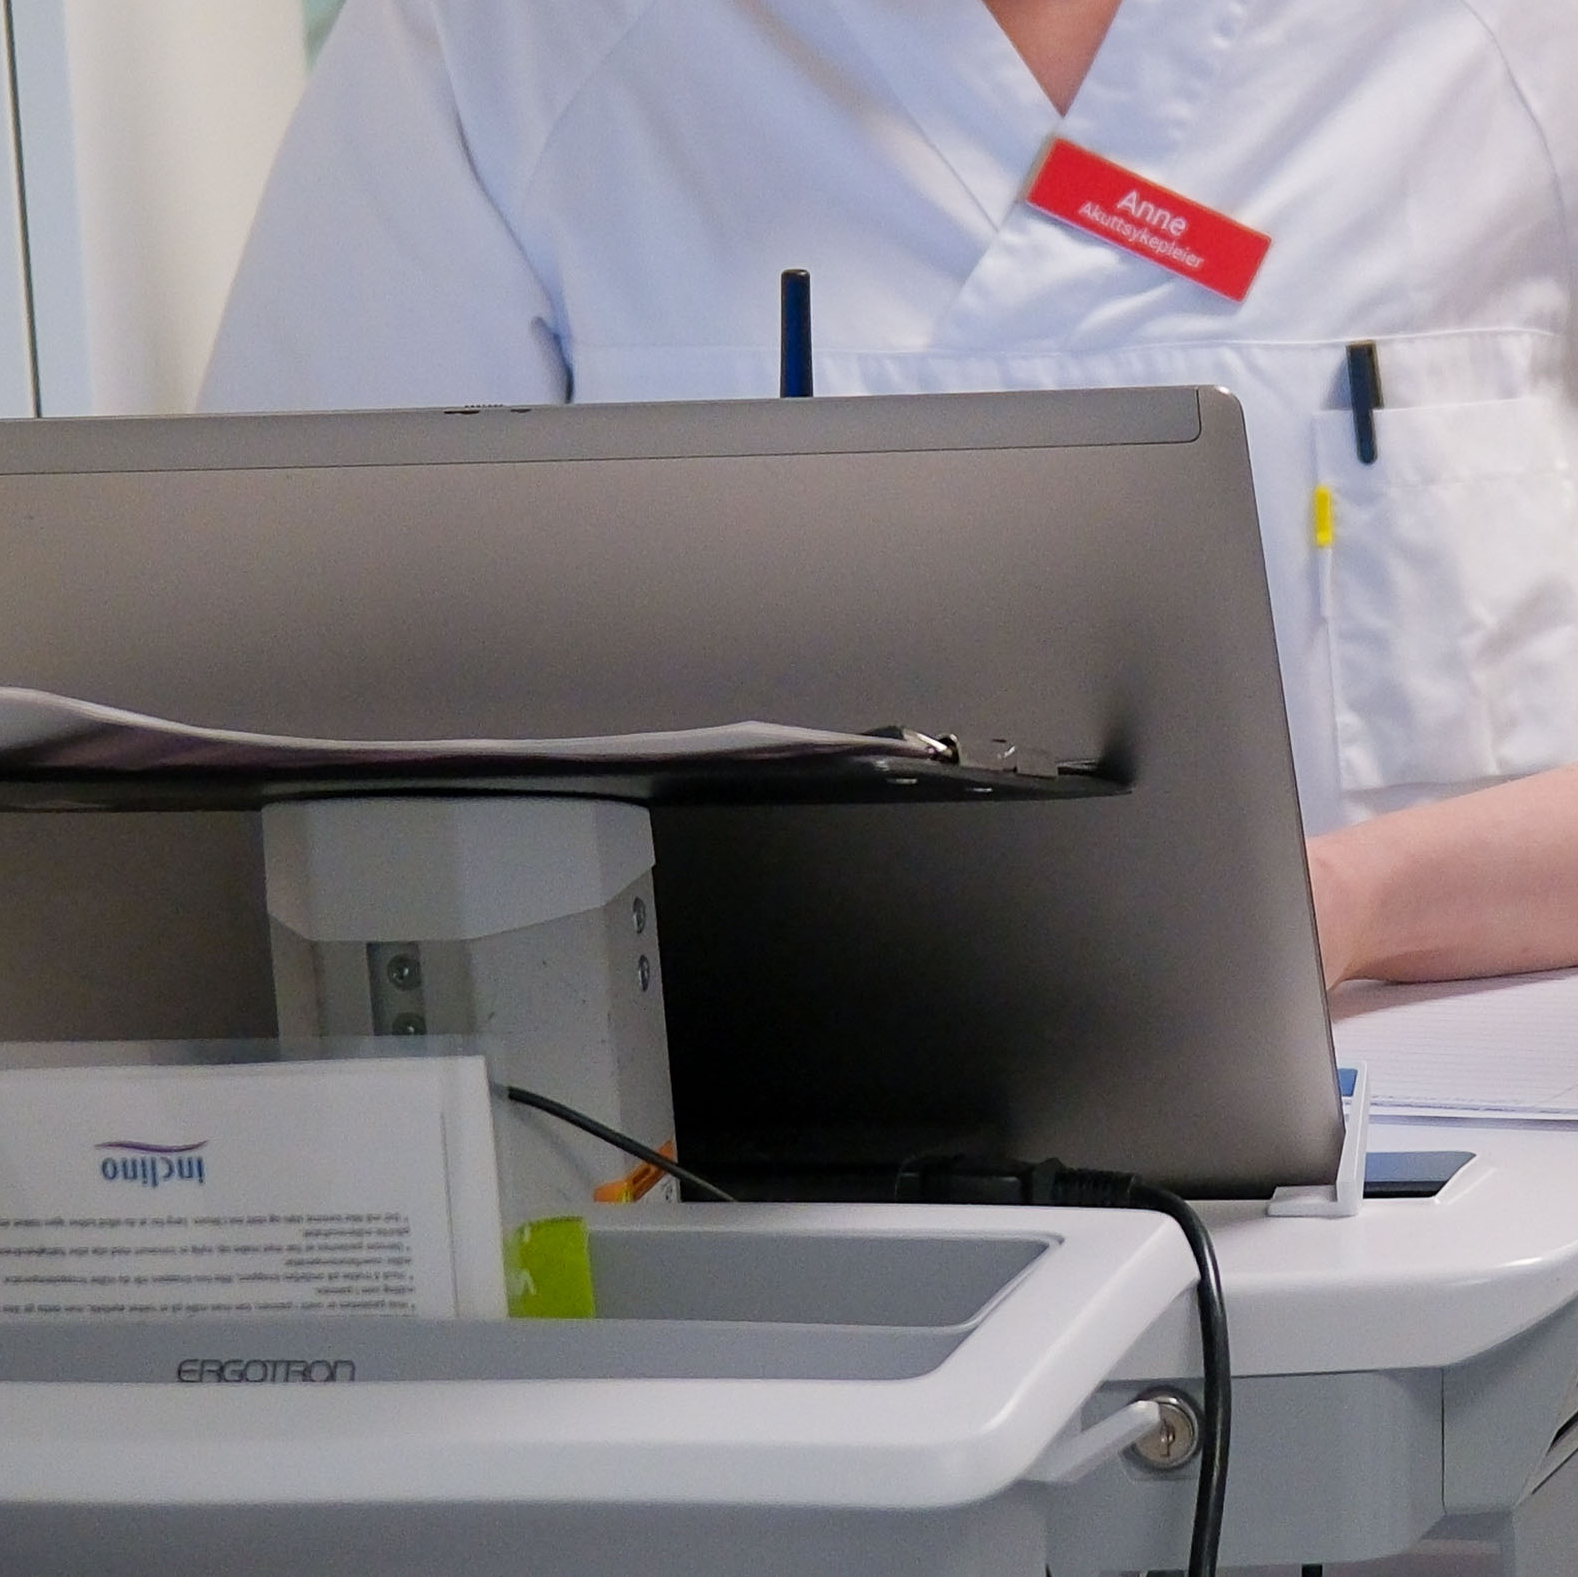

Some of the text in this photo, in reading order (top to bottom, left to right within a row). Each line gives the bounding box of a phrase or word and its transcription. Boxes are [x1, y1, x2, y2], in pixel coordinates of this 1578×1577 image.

[1116, 190, 1189, 236] Anne
[1079, 201, 1205, 269] Akuttsykepleier
[101, 1157, 205, 1189] inclino
[176, 1358, 356, 1383] ERGOTRON
